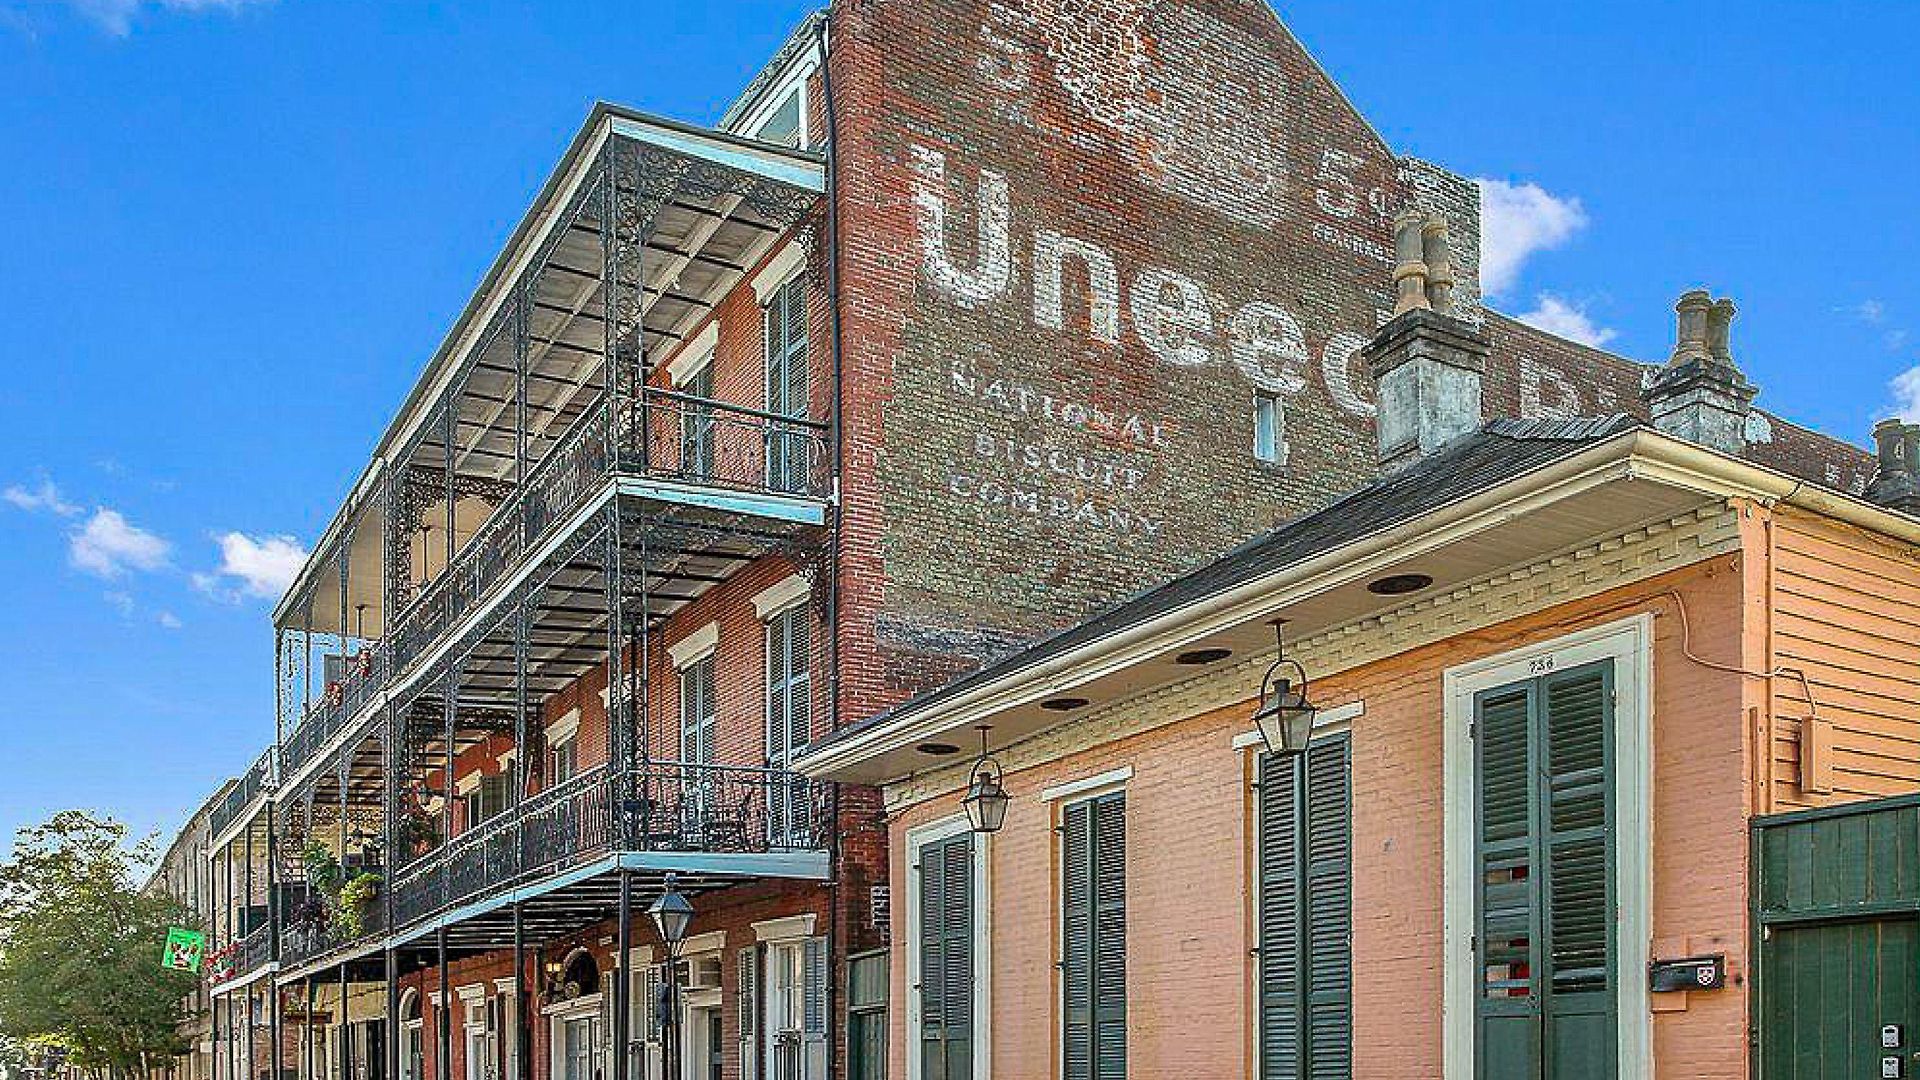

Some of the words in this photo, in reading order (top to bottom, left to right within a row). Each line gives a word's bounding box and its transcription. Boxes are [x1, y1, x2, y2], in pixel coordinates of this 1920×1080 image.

[950, 362, 1171, 448] NATIONAL
[976, 430, 1150, 490] BISCUIT
[948, 474, 1164, 537] COMPANY
